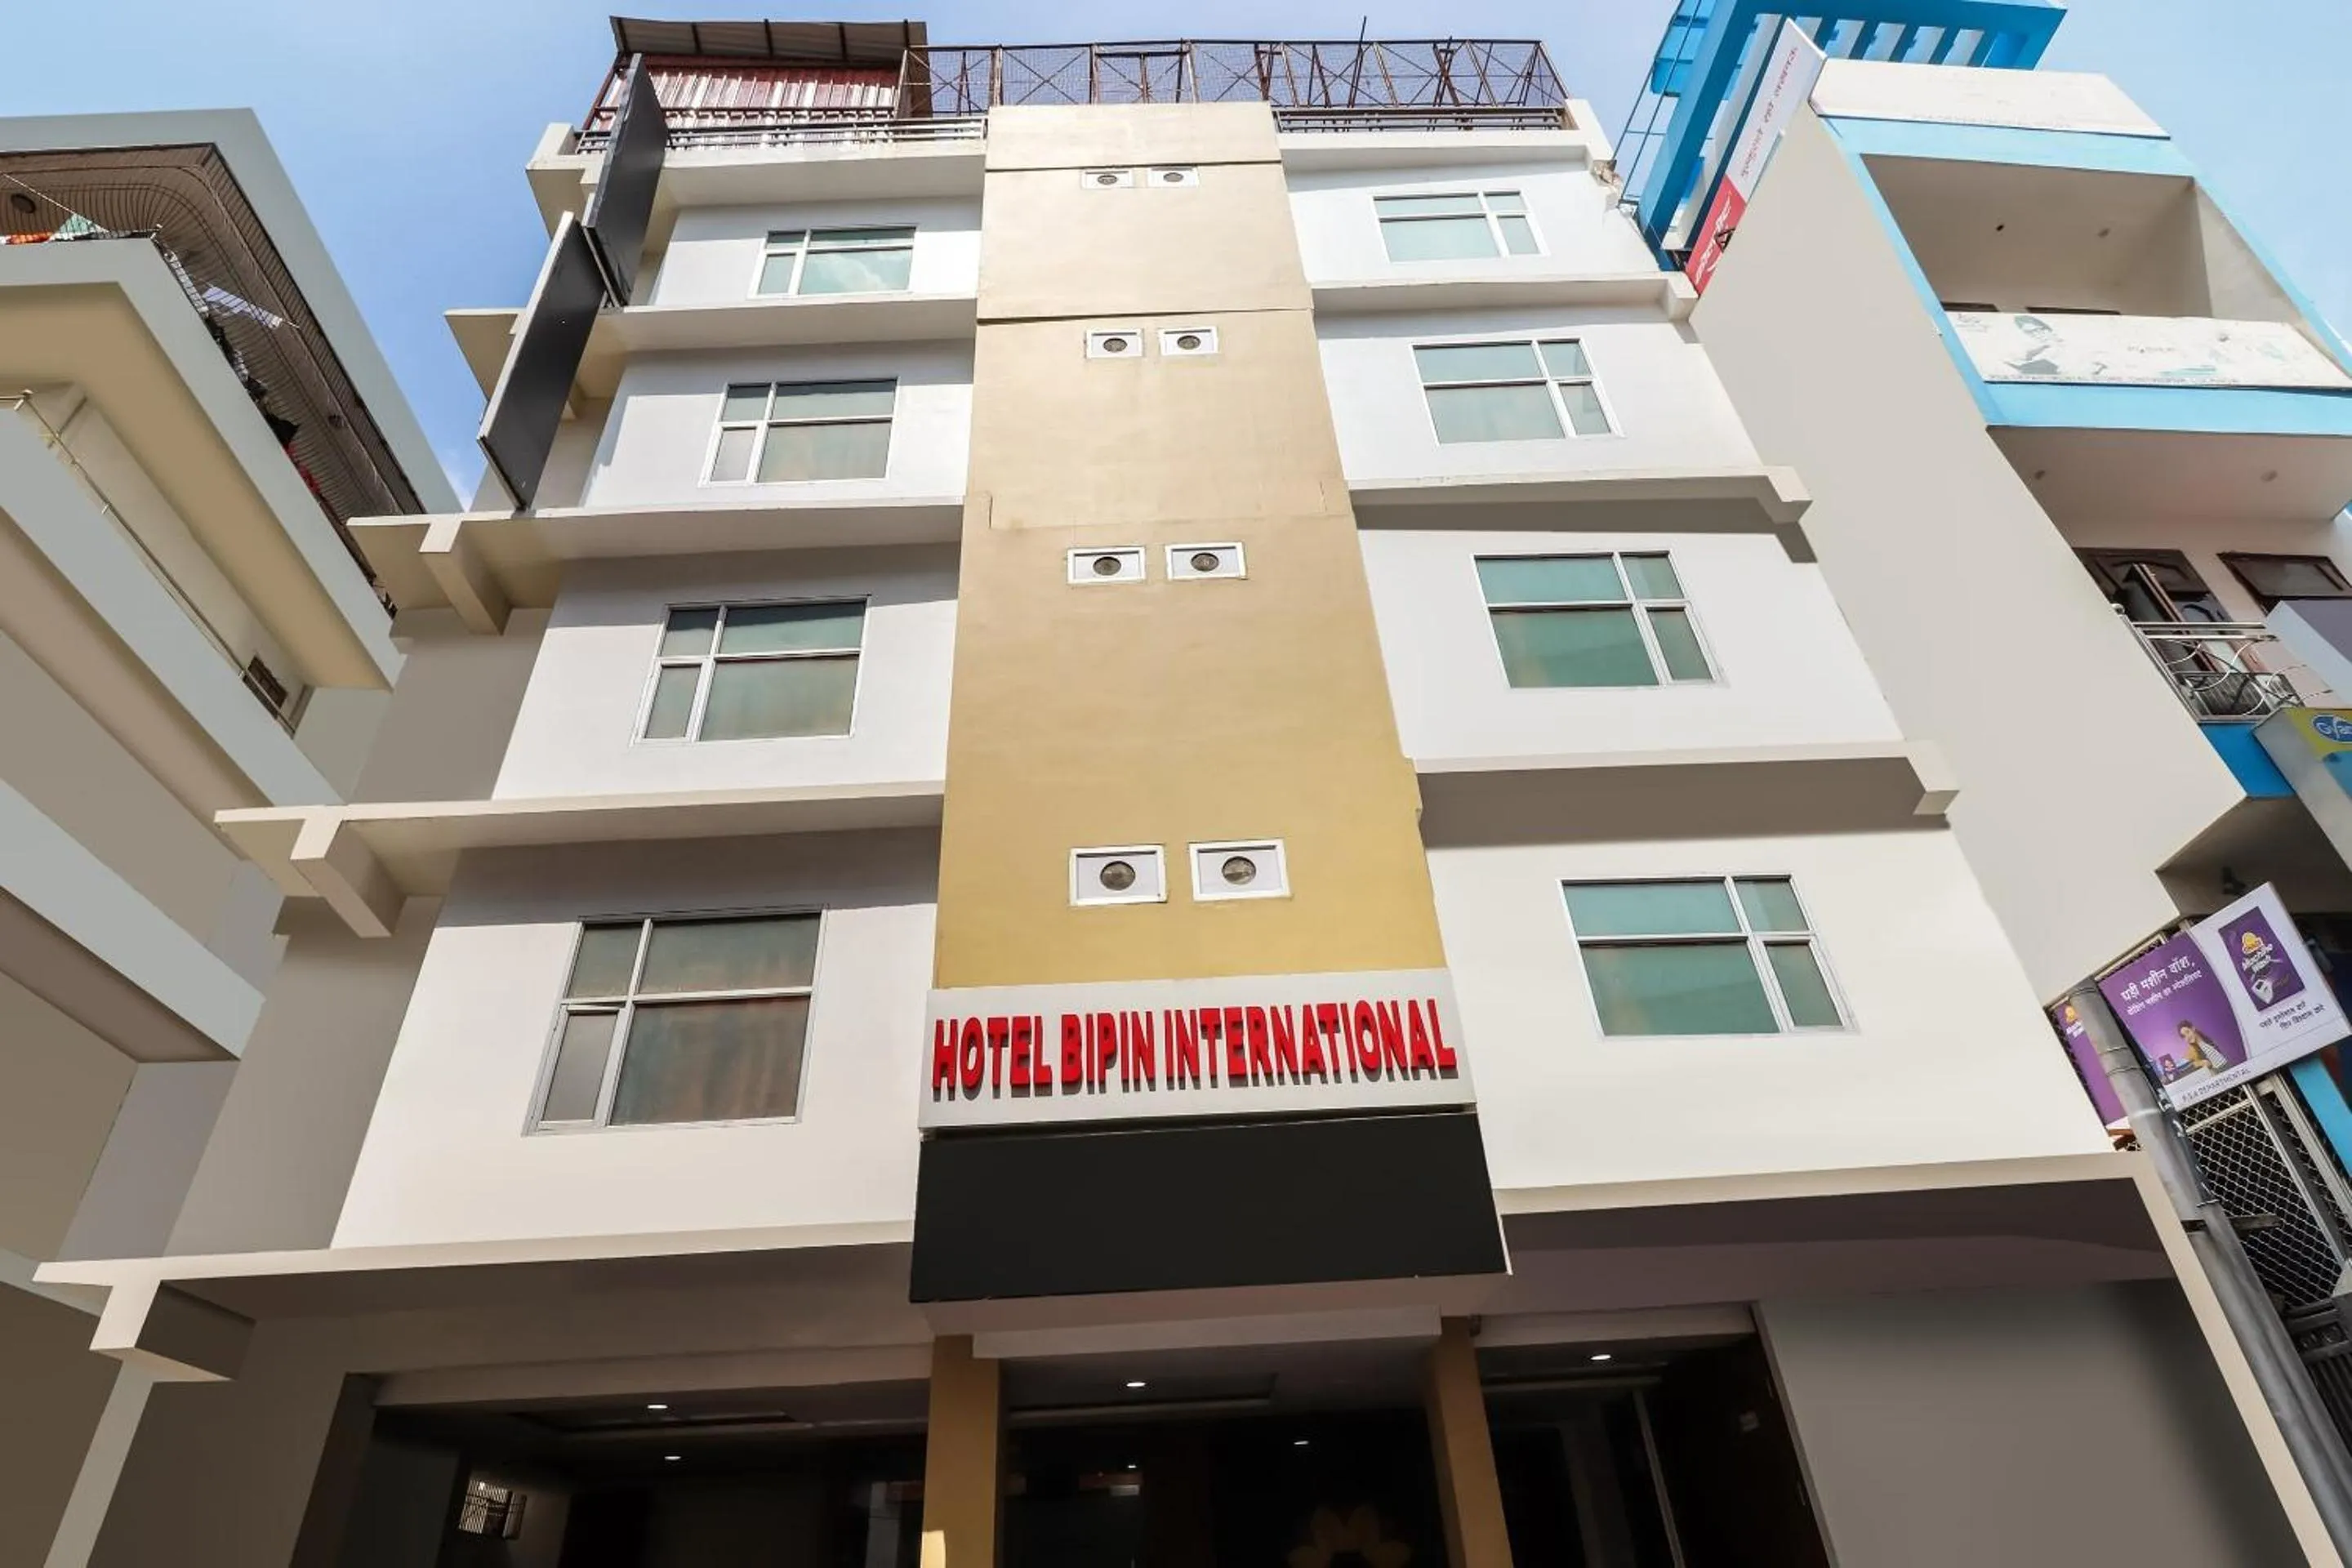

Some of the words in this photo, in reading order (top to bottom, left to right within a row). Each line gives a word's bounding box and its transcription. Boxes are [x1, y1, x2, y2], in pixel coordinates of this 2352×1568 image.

[933, 1015, 1052, 1089] HOTEL
[1060, 1011, 1156, 1085] BIPIN
[1164, 999, 1458, 1078] INTERNATIONAL
